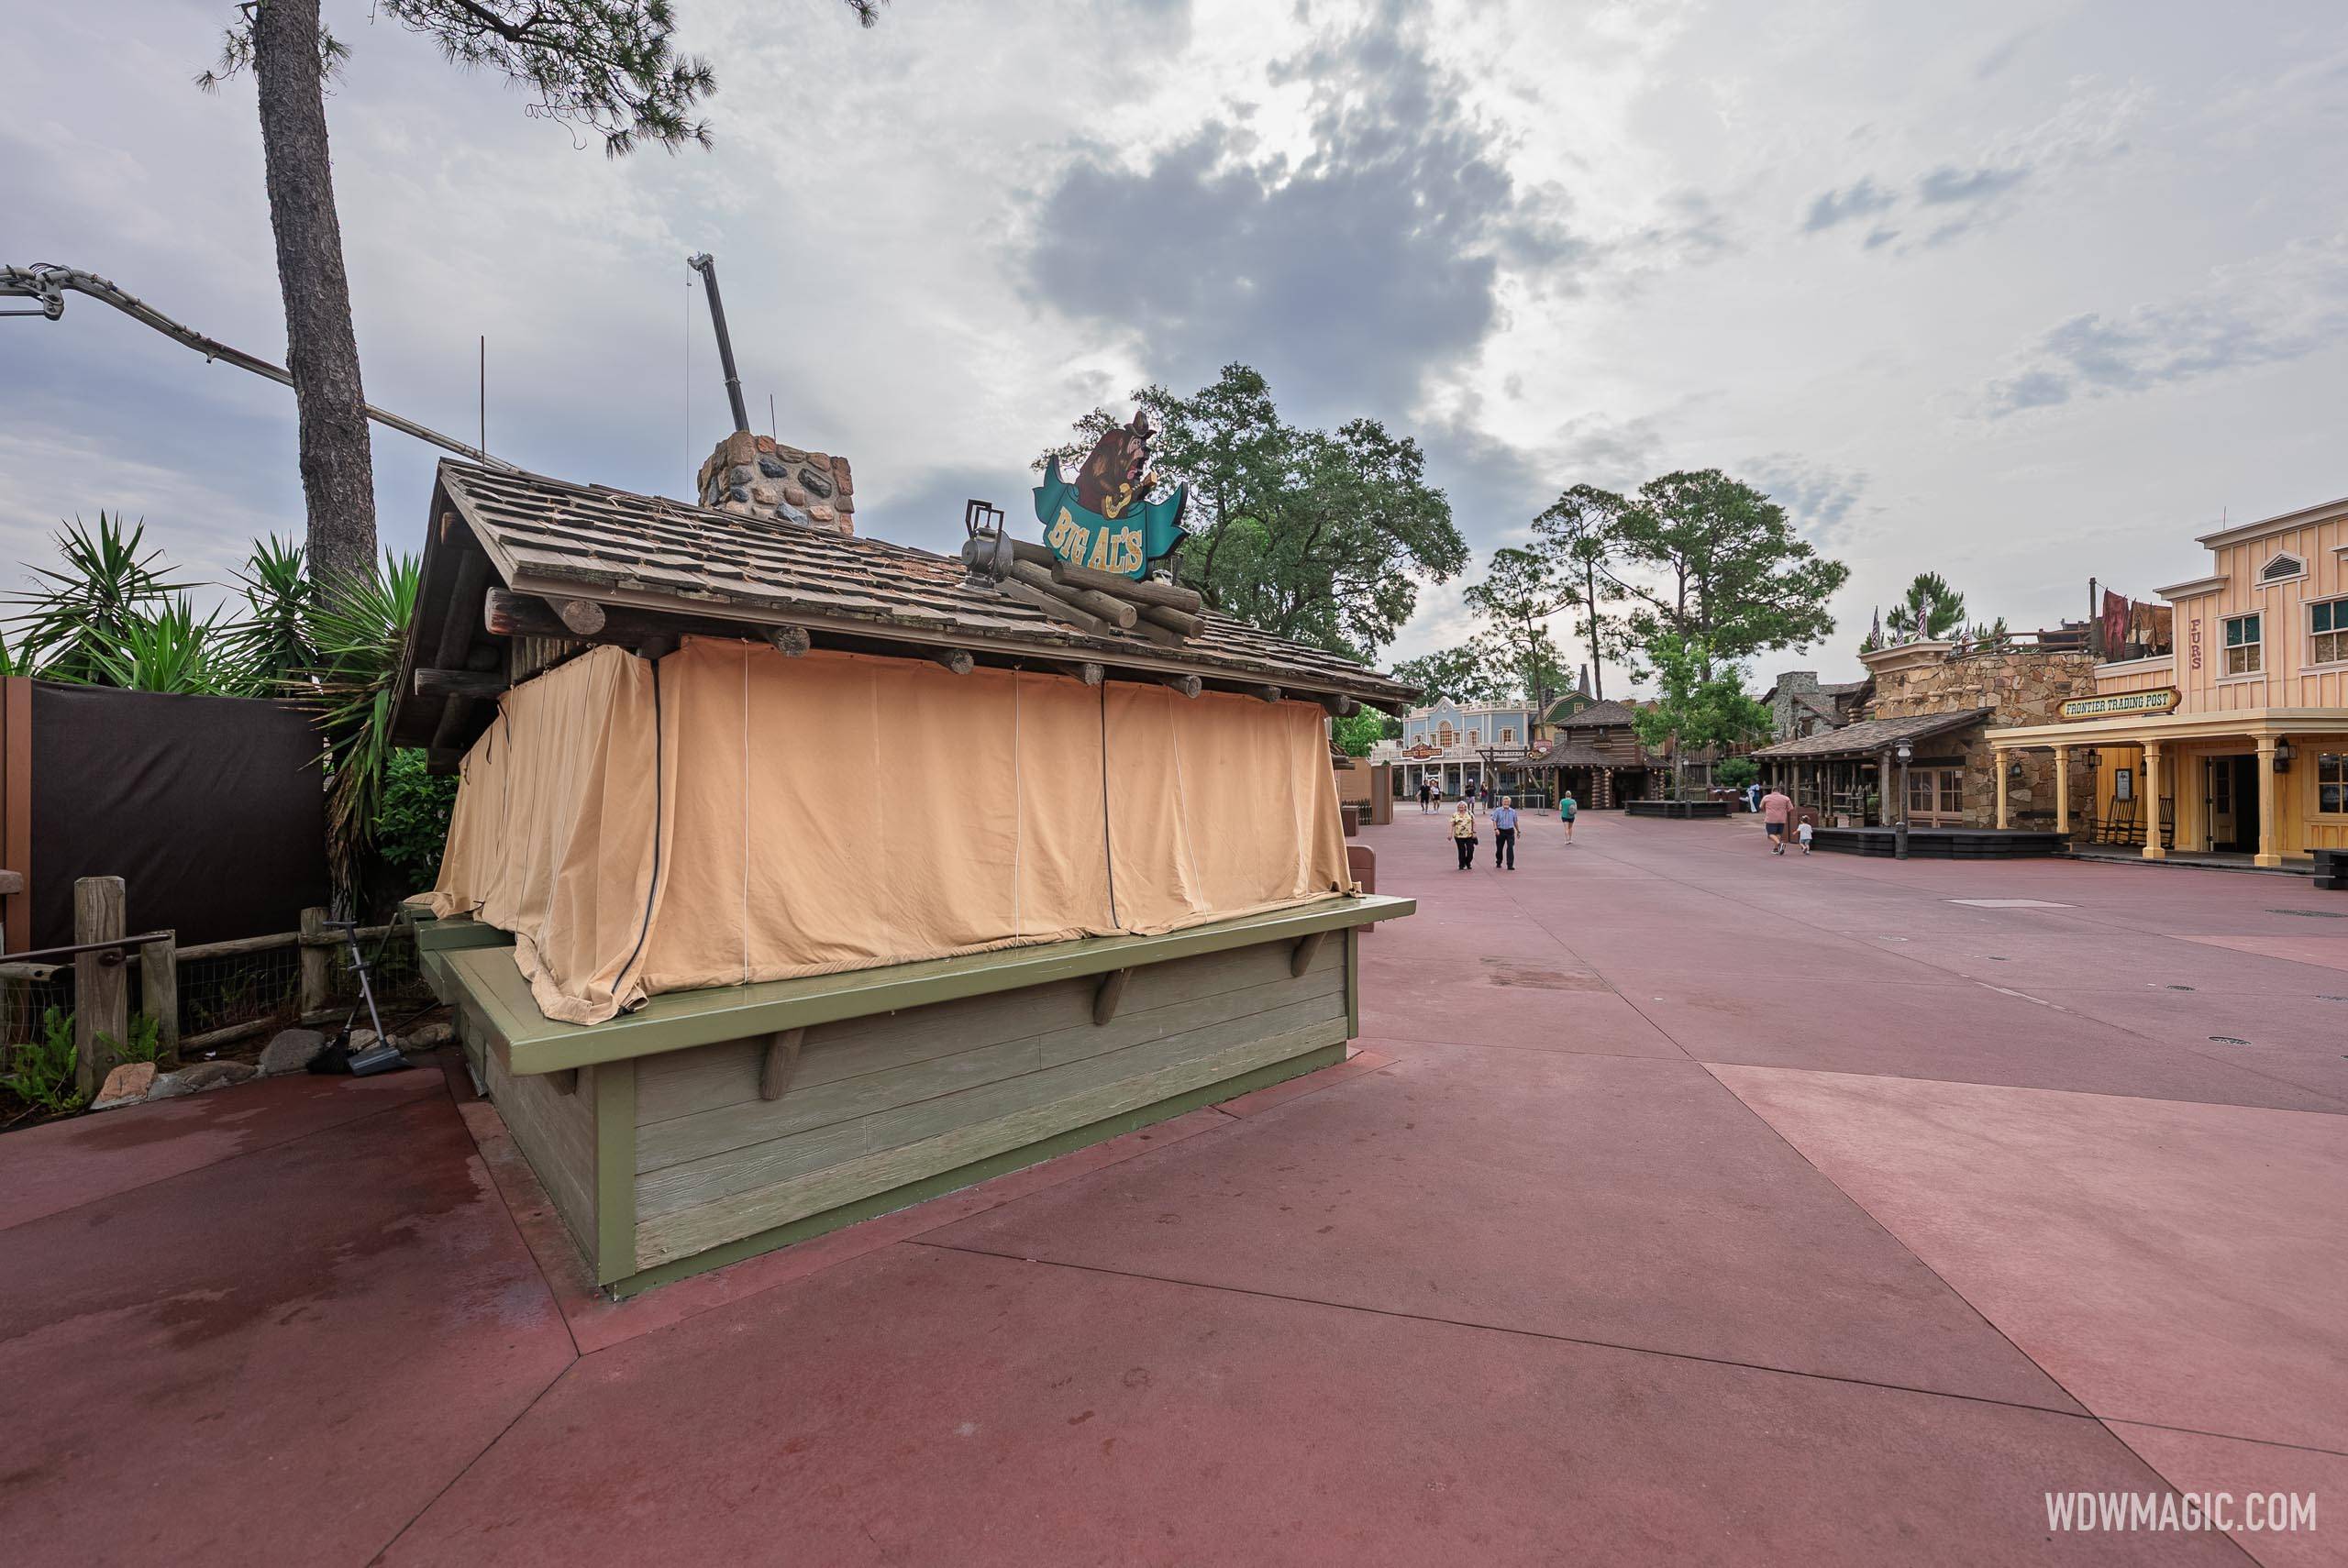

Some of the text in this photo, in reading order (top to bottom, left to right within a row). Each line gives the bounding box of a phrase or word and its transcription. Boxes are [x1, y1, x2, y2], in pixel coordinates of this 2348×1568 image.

[1048, 506, 1143, 574] BIG AL'S
[2190, 618, 2201, 669] FURS
[2066, 692, 2169, 715] FRONTIER TRADING POST
